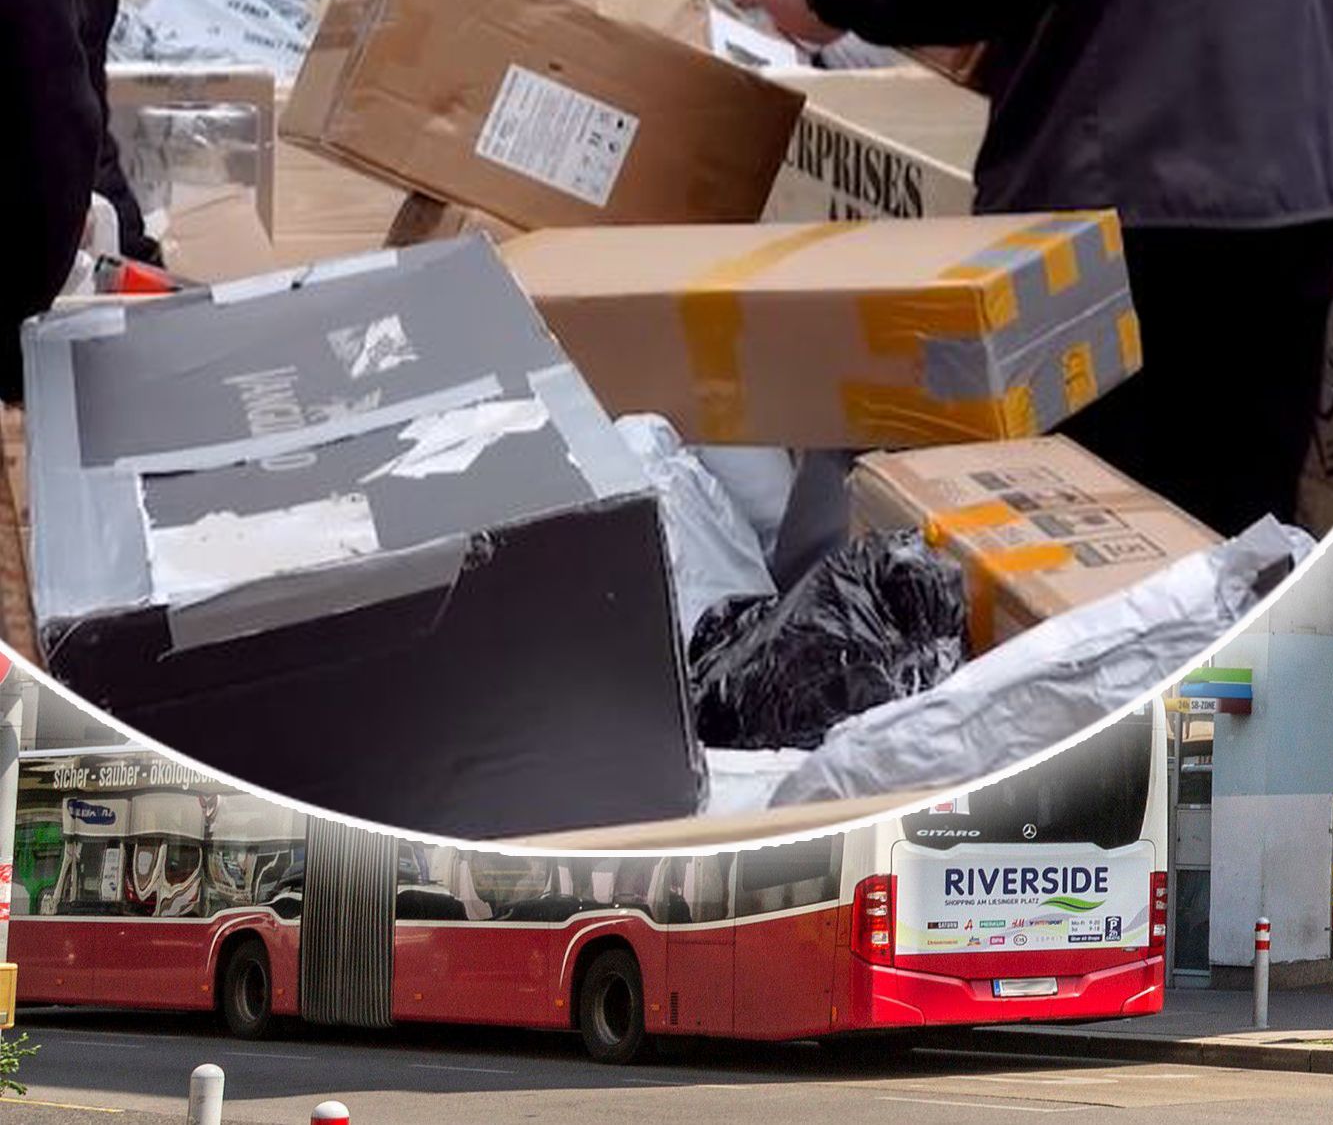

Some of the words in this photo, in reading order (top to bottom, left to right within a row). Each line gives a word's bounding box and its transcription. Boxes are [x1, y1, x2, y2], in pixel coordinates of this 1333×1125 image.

[53, 764, 88, 789] sicher
[99, 761, 141, 787] sauber
[945, 866, 1109, 896] RIVERSIDE
